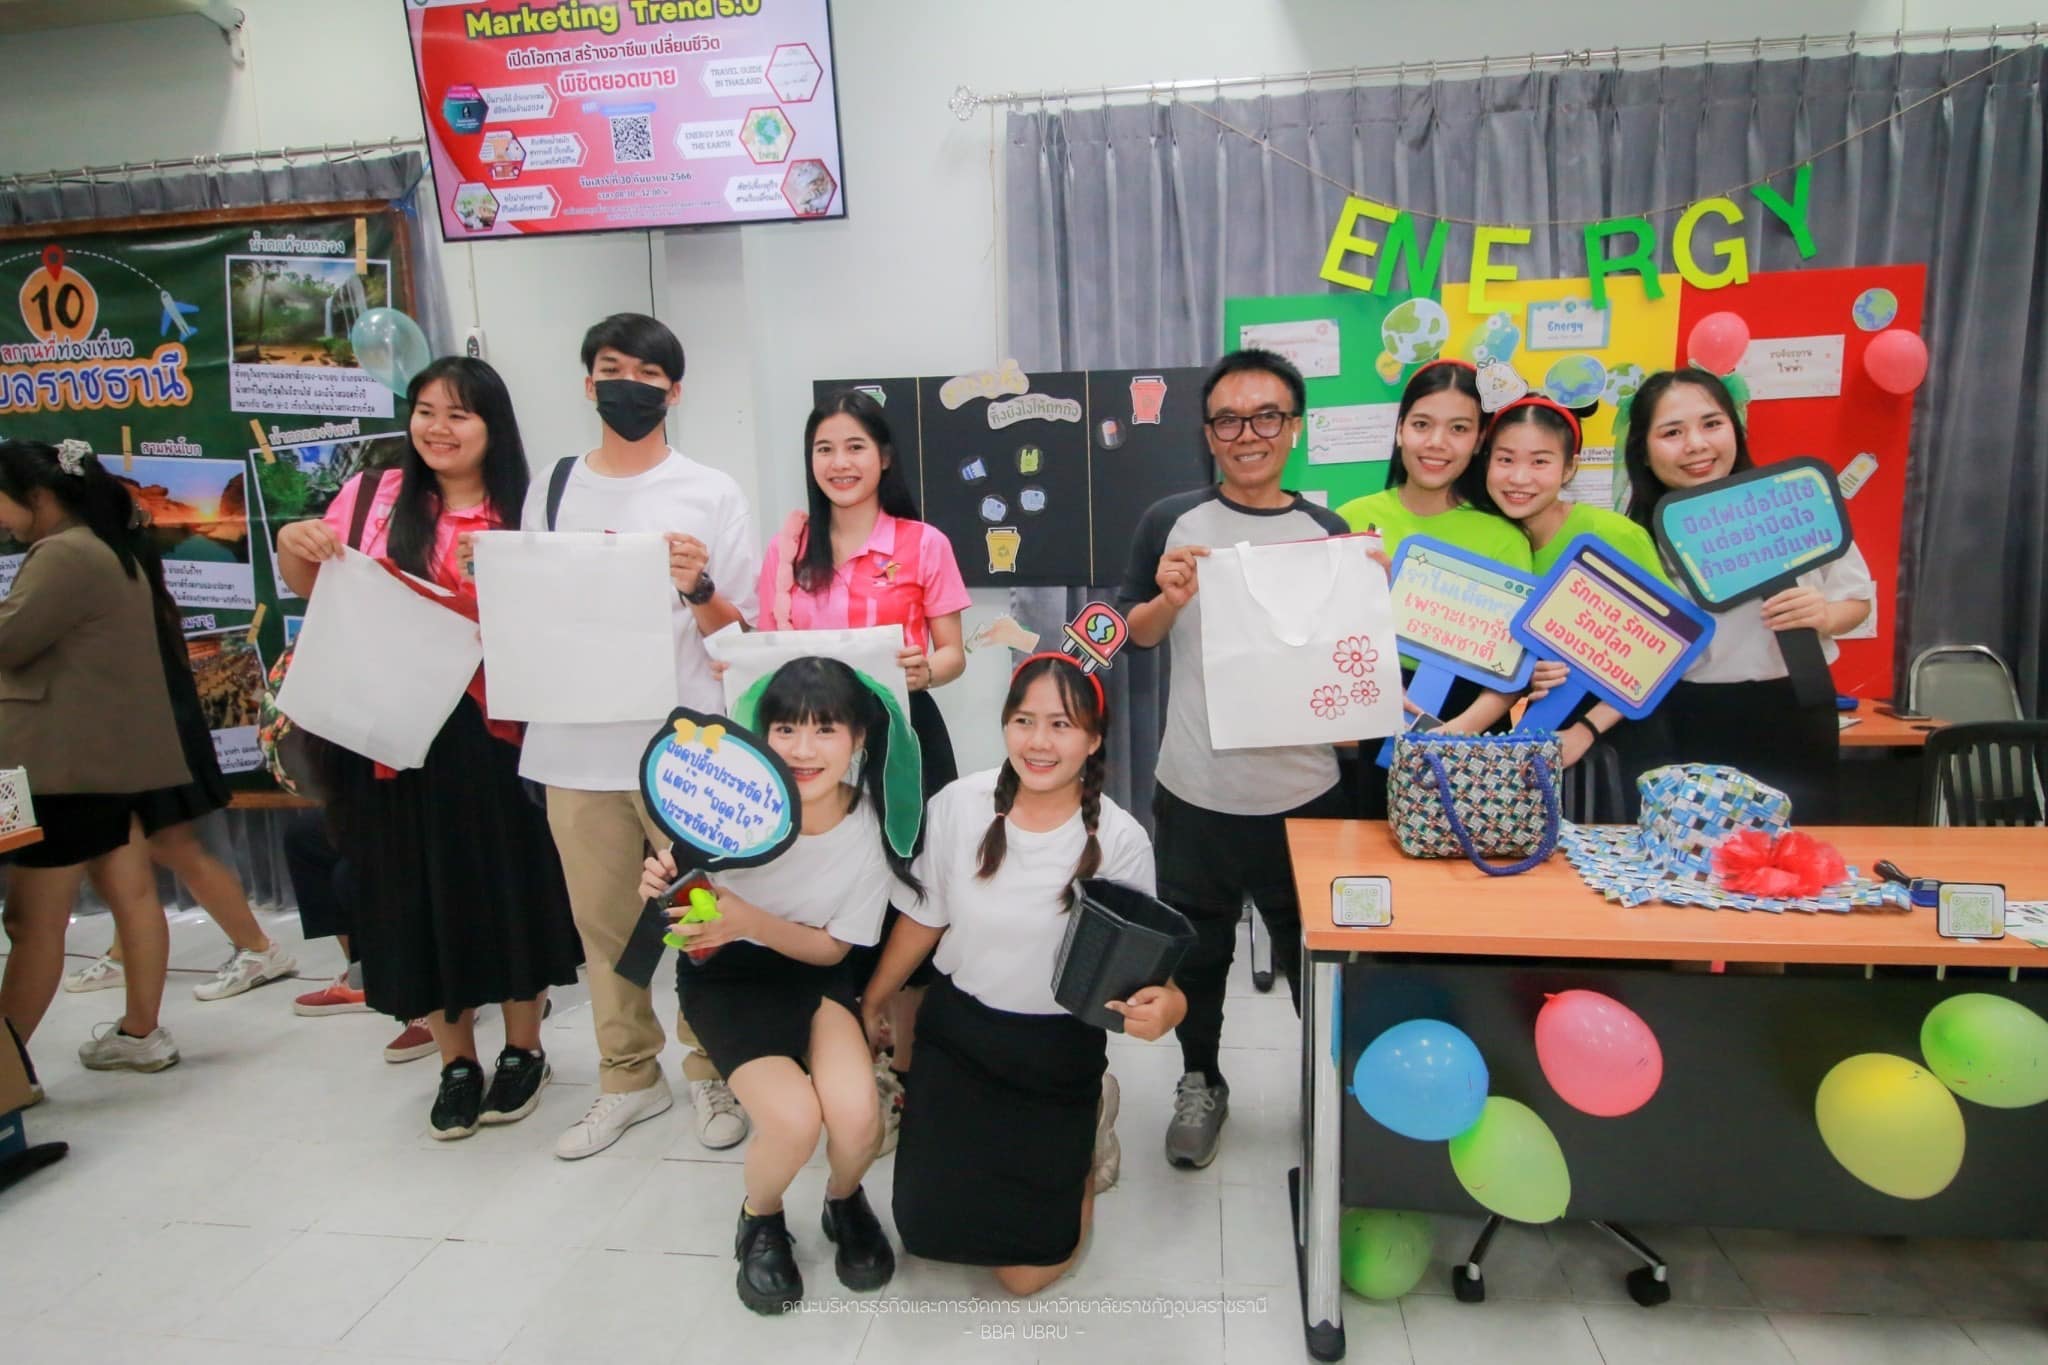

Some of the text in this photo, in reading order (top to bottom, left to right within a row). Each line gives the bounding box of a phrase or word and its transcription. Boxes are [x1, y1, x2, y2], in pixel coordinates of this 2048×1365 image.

[465, 0, 761, 35] Marketing Trend 5.0
[508, 34, 720, 68] เปิดโอกาส สร้างอาชีพ เปลี่ยนชีวิต
[710, 66, 738, 76] TRAVEL
[560, 68, 677, 94] พิชิตยอดขาย
[725, 77, 762, 87] THAILAND
[691, 140, 731, 151] THE EARTH
[715, 128, 735, 138] SAVE
[1318, 163, 1818, 314] ENERGY
[30, 283, 86, 332] 10
[1547, 321, 1584, 332] Energy
[2, 331, 134, 362] สถานที่ท่องเที่ยว
[1682, 478, 1816, 536] ปิดไฟเมื่อไม่ใช้
[1701, 505, 1816, 555] แต่อย่าปิดใจ
[1700, 527, 1833, 580] ถ้าอยากมีแฟน
[1569, 577, 1625, 625] รักทะเล
[1622, 614, 1668, 655] รักเขา
[1574, 609, 1632, 659] รักษ์โลก
[1406, 617, 1498, 662] ธรรมชาติ
[1544, 617, 1642, 692] ของเราด้วยนะ
